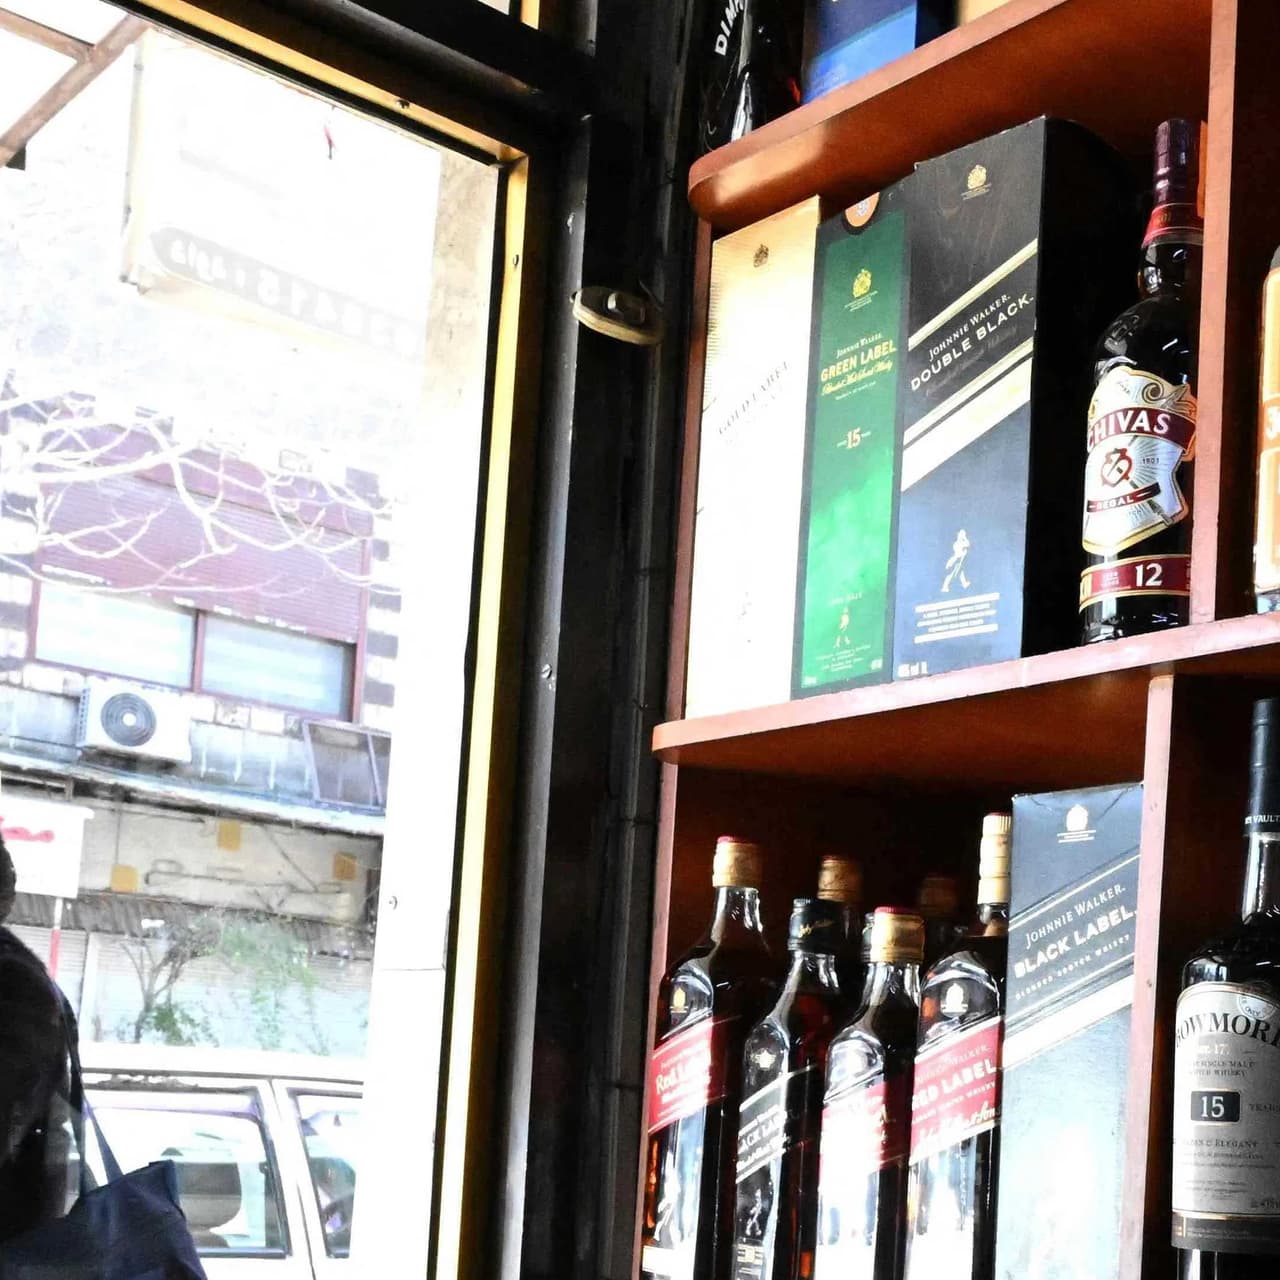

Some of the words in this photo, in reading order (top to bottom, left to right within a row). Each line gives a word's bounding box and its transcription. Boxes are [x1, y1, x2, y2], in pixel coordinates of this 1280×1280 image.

[929, 324, 969, 359] JOHNNIE
[821, 356, 857, 382] GREEN
[860, 340, 898, 365] LABEL
[911, 339, 972, 391] DOUBLE
[846, 428, 862, 449] 15
[1088, 410, 1171, 447] CHIVAS
[1135, 562, 1163, 587] 12
[1025, 912, 1073, 950] JOHNNIE
[1014, 936, 1071, 979] BLACK
[1201, 1095, 1225, 1118] 15
